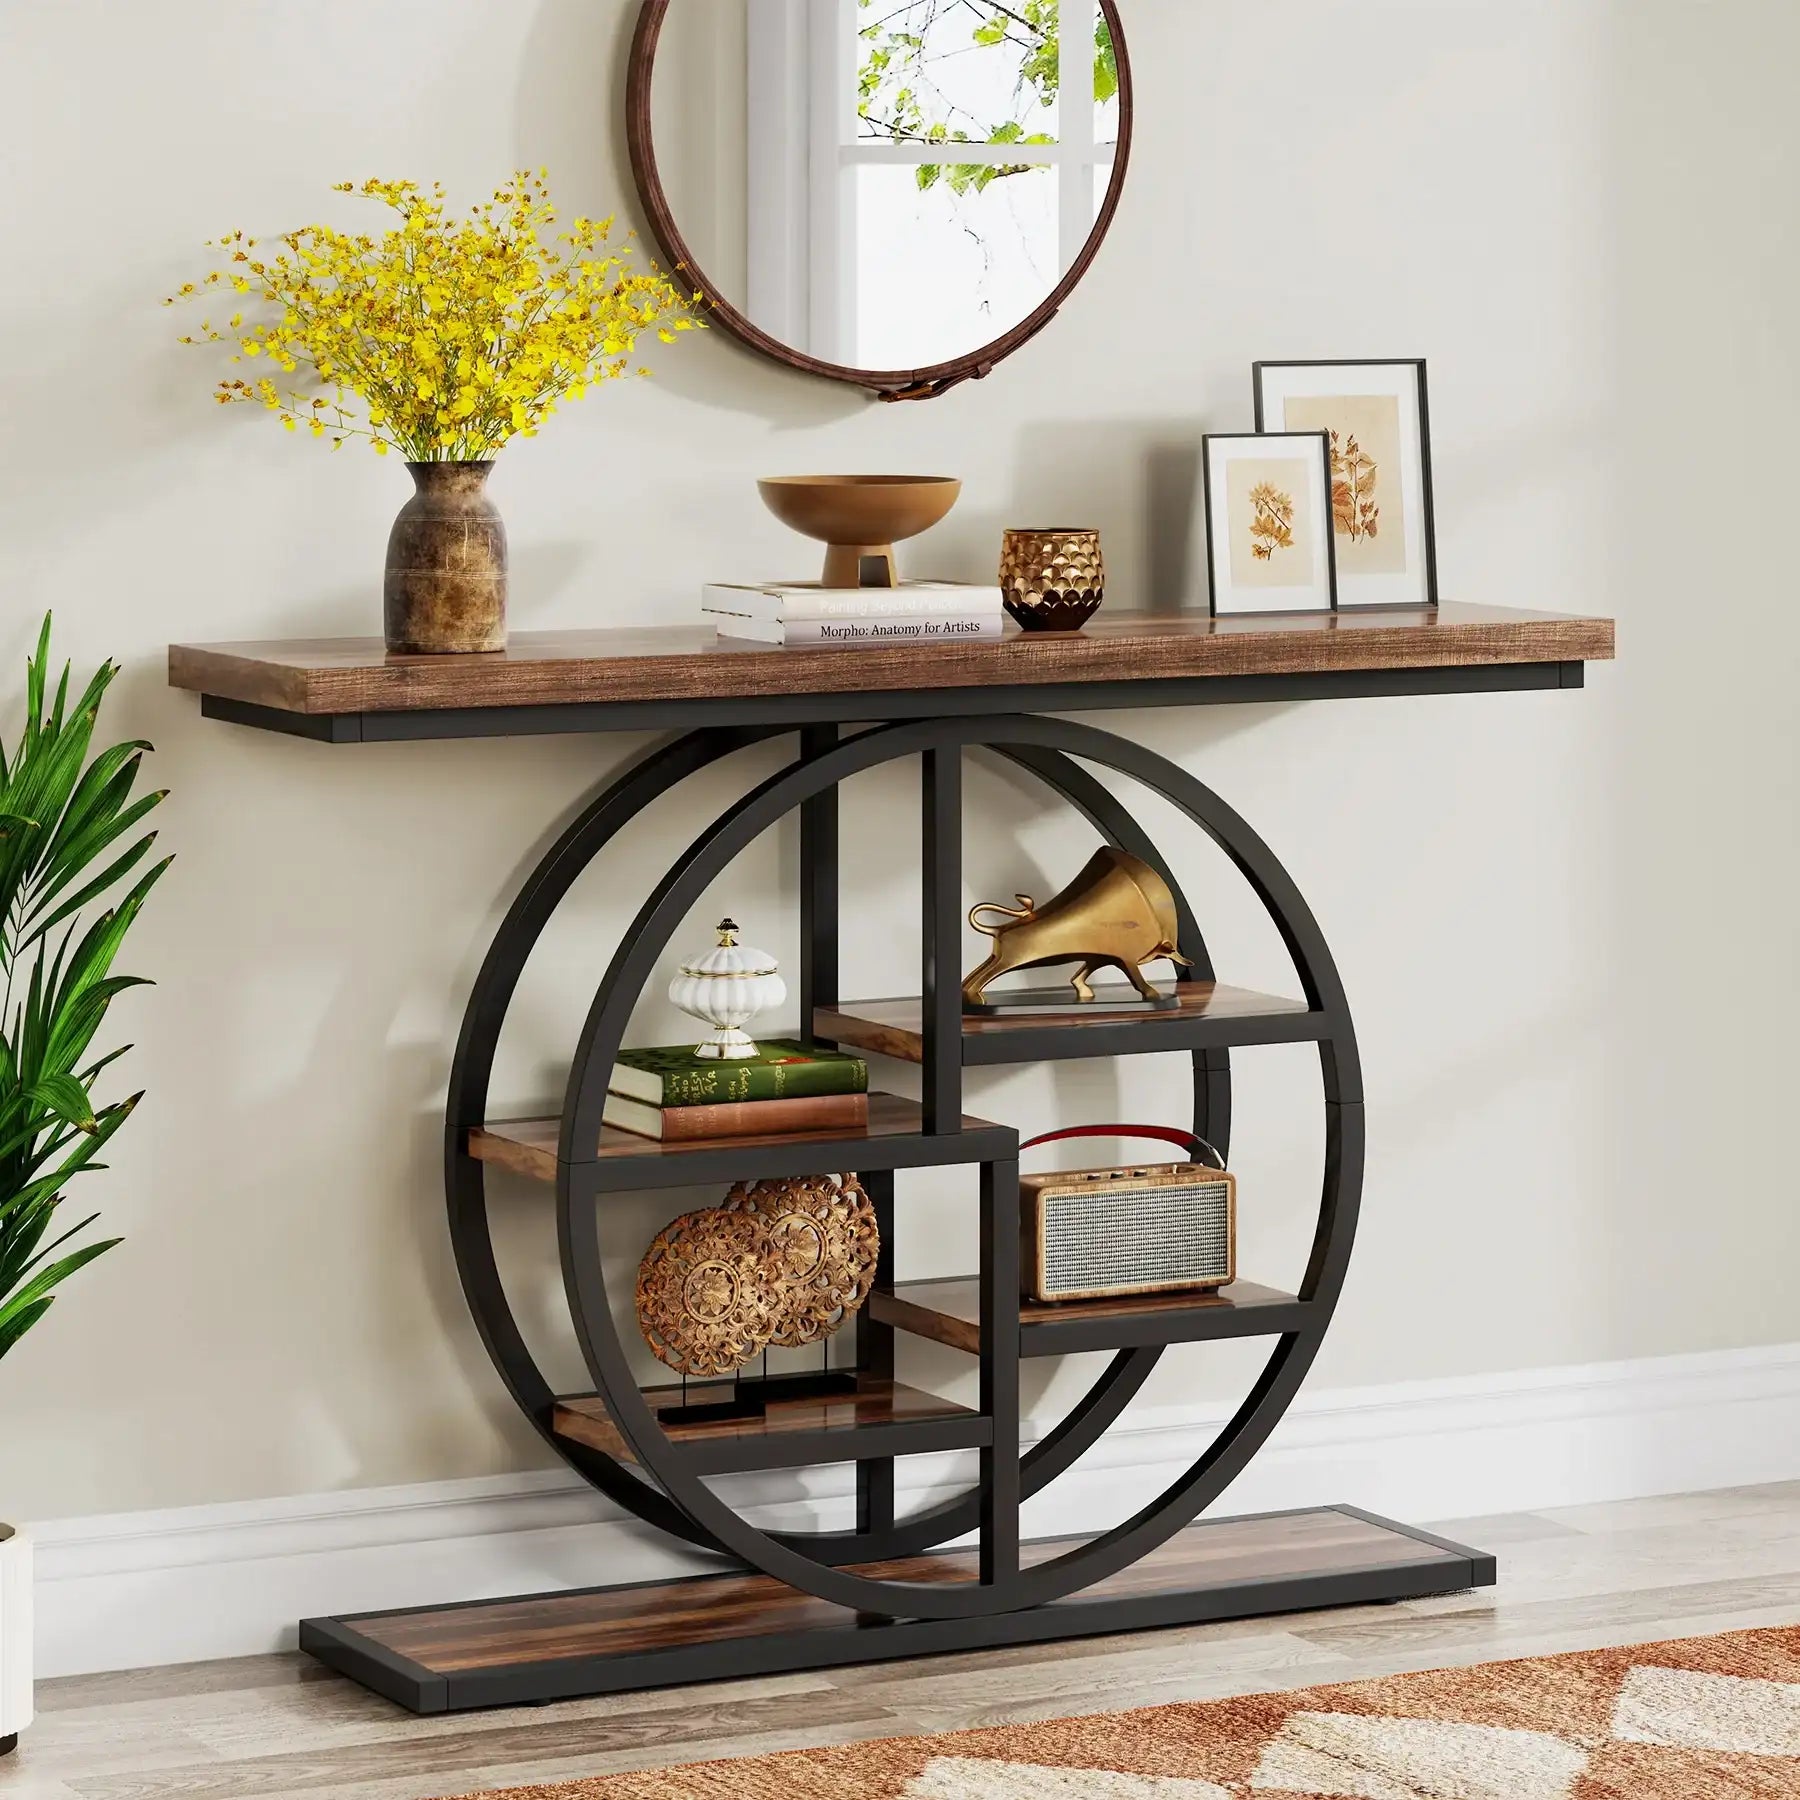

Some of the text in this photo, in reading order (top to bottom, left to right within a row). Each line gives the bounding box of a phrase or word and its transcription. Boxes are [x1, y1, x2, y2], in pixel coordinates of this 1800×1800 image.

[820, 621, 980, 640] Morpho: Anatomy for Artists
